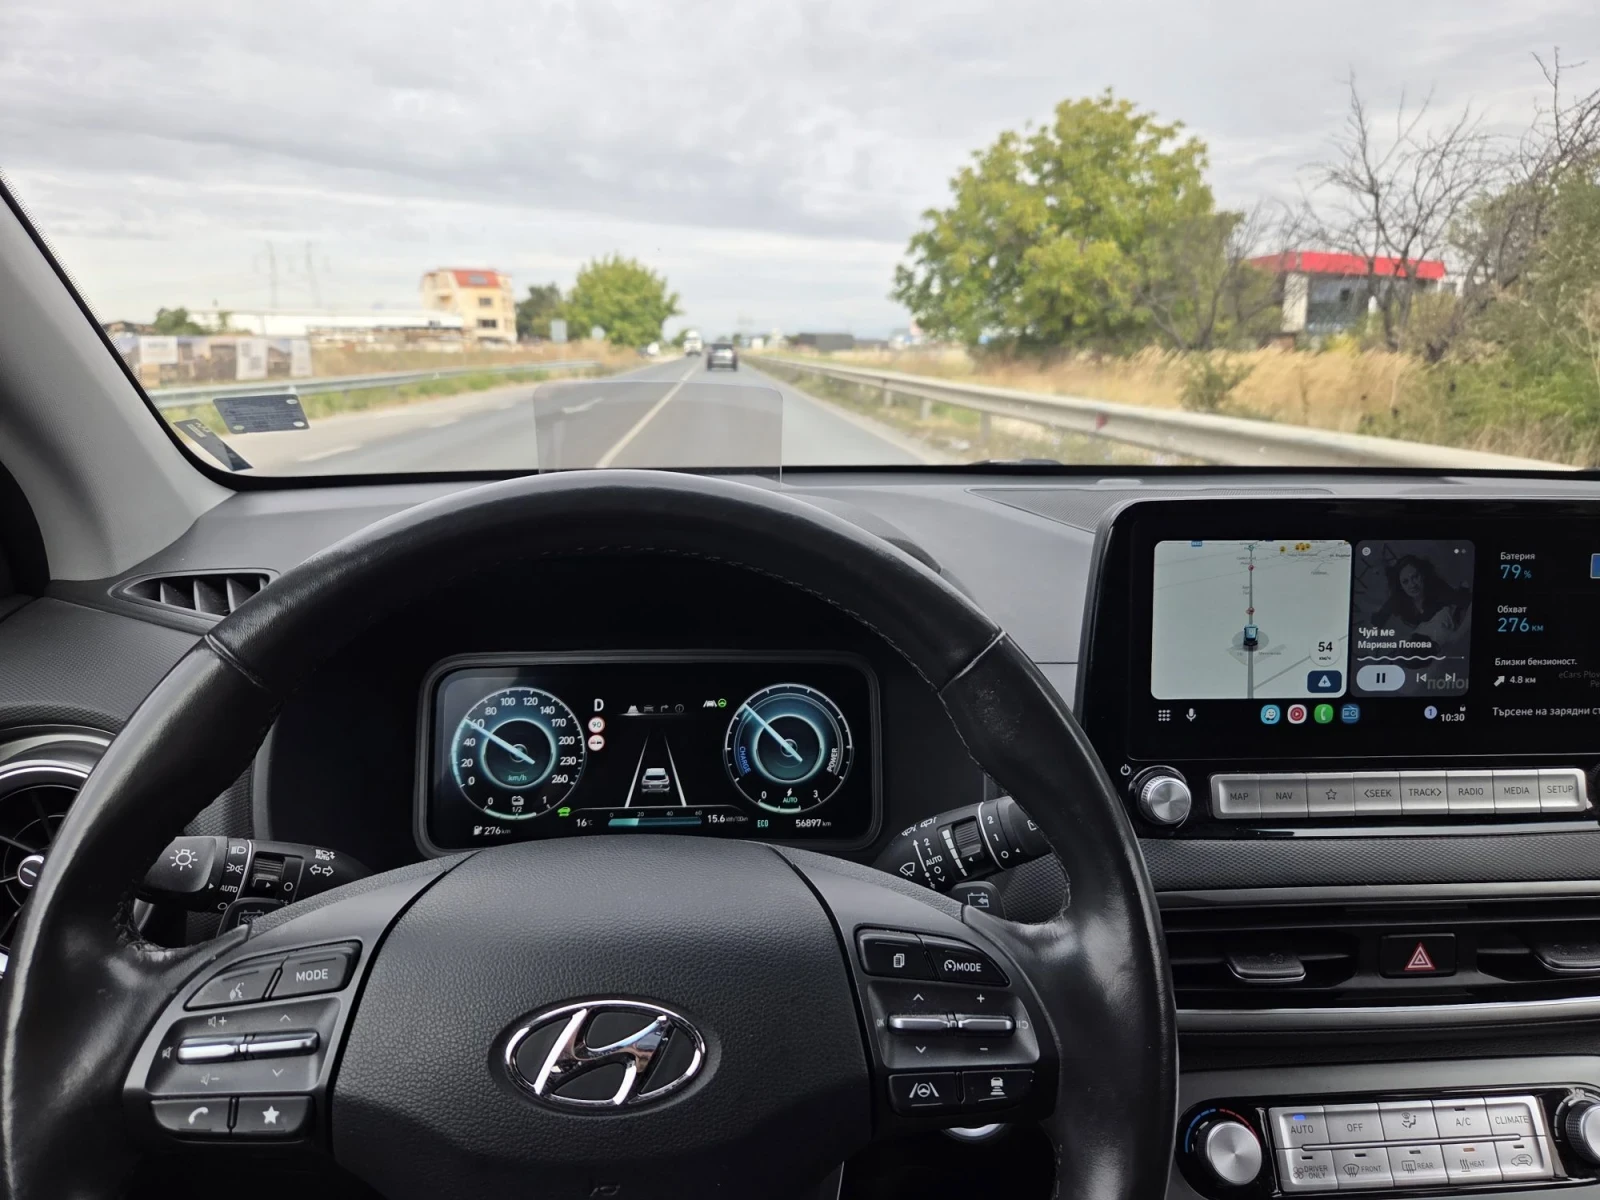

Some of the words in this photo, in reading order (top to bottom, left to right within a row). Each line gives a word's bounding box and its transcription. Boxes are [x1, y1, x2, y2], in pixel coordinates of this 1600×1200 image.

[1500, 551, 1536, 561] Батерия
[1500, 564, 1522, 579] 79
[1497, 605, 1527, 614] Обхват
[1497, 617, 1530, 633] 276
[1358, 627, 1378, 638] Чуй
[1380, 629, 1396, 637] ме
[1318, 641, 1333, 652] 54
[1357, 640, 1397, 650] Мариана
[1398, 640, 1432, 649] Попова
[1494, 657, 1526, 666] Близки
[1509, 675, 1524, 684] 4.8
[1525, 676, 1537, 684] км
[500, 697, 516, 706] 100
[523, 697, 538, 706] 120
[594, 698, 604, 711] D
[485, 706, 497, 716] 80
[540, 706, 555, 714] 140
[1492, 706, 1533, 717] Търсене
[1535, 708, 1548, 716] на
[1549, 707, 1590, 717] зарядни
[1440, 713, 1465, 722] 10:30
[551, 719, 567, 727] 170
[463, 738, 476, 747] 40
[558, 737, 575, 746] 200
[460, 758, 474, 768] 20
[560, 757, 577, 766] 230
[739, 746, 751, 773] CHARGE
[827, 748, 838, 773] POWER
[468, 776, 476, 786] 0
[508, 774, 528, 782] km/h
[551, 774, 569, 784] 260
[1457, 787, 1484, 797] RADIO
[1503, 785, 1530, 796] MEDIA
[1546, 784, 1574, 794] SETUP
[761, 790, 767, 799] 0
[813, 790, 819, 798] 3
[1230, 792, 1249, 801] MAP
[1275, 791, 1293, 800] NAV
[487, 796, 494, 805] 0
[576, 818, 587, 827] 16
[707, 814, 726, 824] 15.6
[795, 819, 822, 827] 56897
[987, 815, 995, 824] 2
[757, 820, 769, 828] ECO
[484, 826, 501, 835] 276
[923, 838, 931, 847] 2
[925, 855, 943, 867] AUTO
[220, 885, 238, 893] AUTO
[956, 962, 982, 972] MODE
[296, 969, 328, 981] MODE
[876, 1018, 885, 1027] OK
[1455, 1117, 1472, 1126] A/C
[1494, 1115, 1530, 1125] CLIMATE
[1290, 1124, 1314, 1134] AUTO
[1346, 1123, 1364, 1132] OFF
[1469, 1160, 1486, 1168] HEAT
[1303, 1165, 1328, 1173] DRIVER
[1361, 1165, 1382, 1173] FRONT
[1308, 1171, 1326, 1179] ONLY
